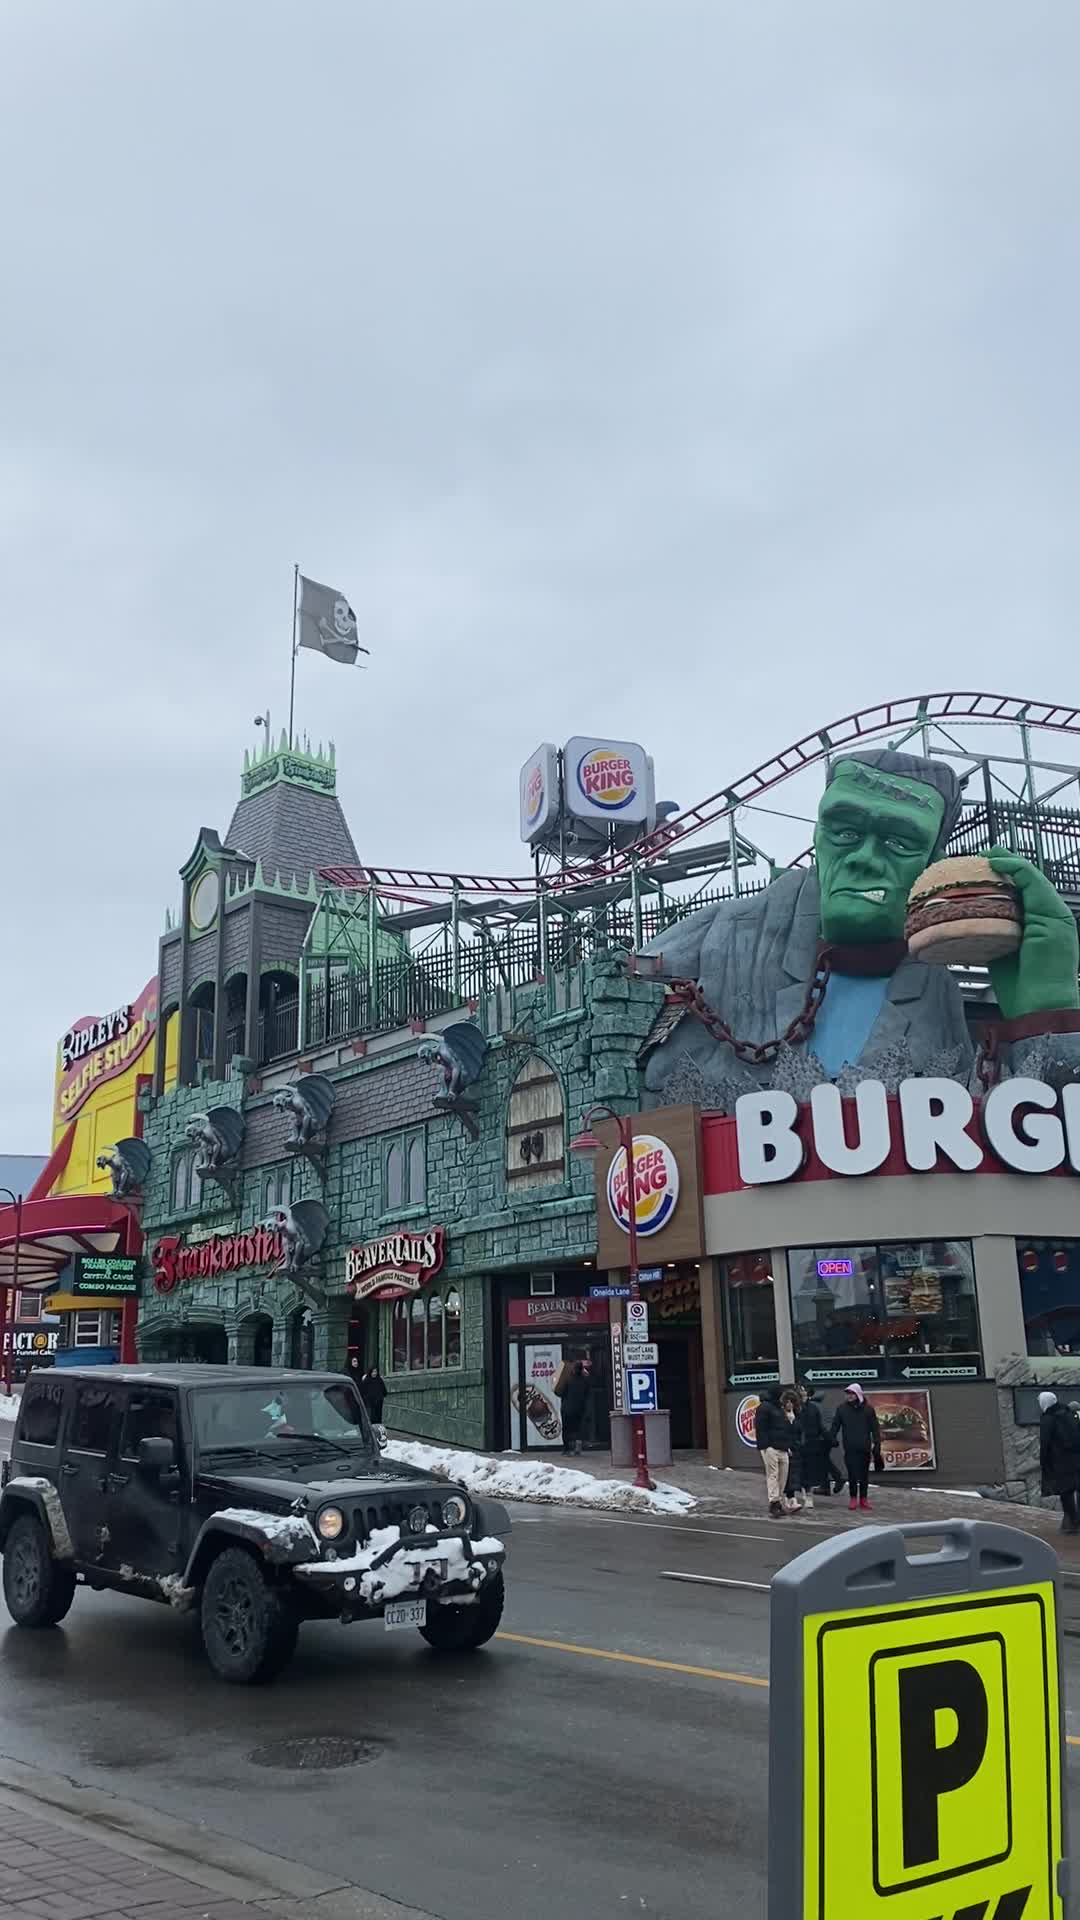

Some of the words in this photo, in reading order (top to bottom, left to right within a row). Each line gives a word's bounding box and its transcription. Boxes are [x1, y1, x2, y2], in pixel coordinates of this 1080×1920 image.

[583, 759, 631, 778] BURGER
[586, 771, 634, 795] KING
[62, 1005, 129, 1071] RIPLEY'S
[60, 1050, 104, 1113] SELFIE
[735, 1077, 1080, 1185] BURG
[613, 1149, 664, 1194] BUGER
[616, 1165, 667, 1217] KNG
[820, 1262, 849, 1274] OPEN
[593, 1288, 615, 1297] Oneida
[615, 1287, 630, 1296] Lane
[533, 1361, 547, 1369] ADD
[548, 1361, 554, 1369] A
[613, 1338, 622, 1406] ENTRANCE
[812, 1370, 876, 1378] ENTRANCE
[909, 1368, 975, 1376] ENTRANCE
[631, 1373, 650, 1400] P
[885, 1452, 929, 1464] OPPER
[898, 1659, 988, 1870] P
